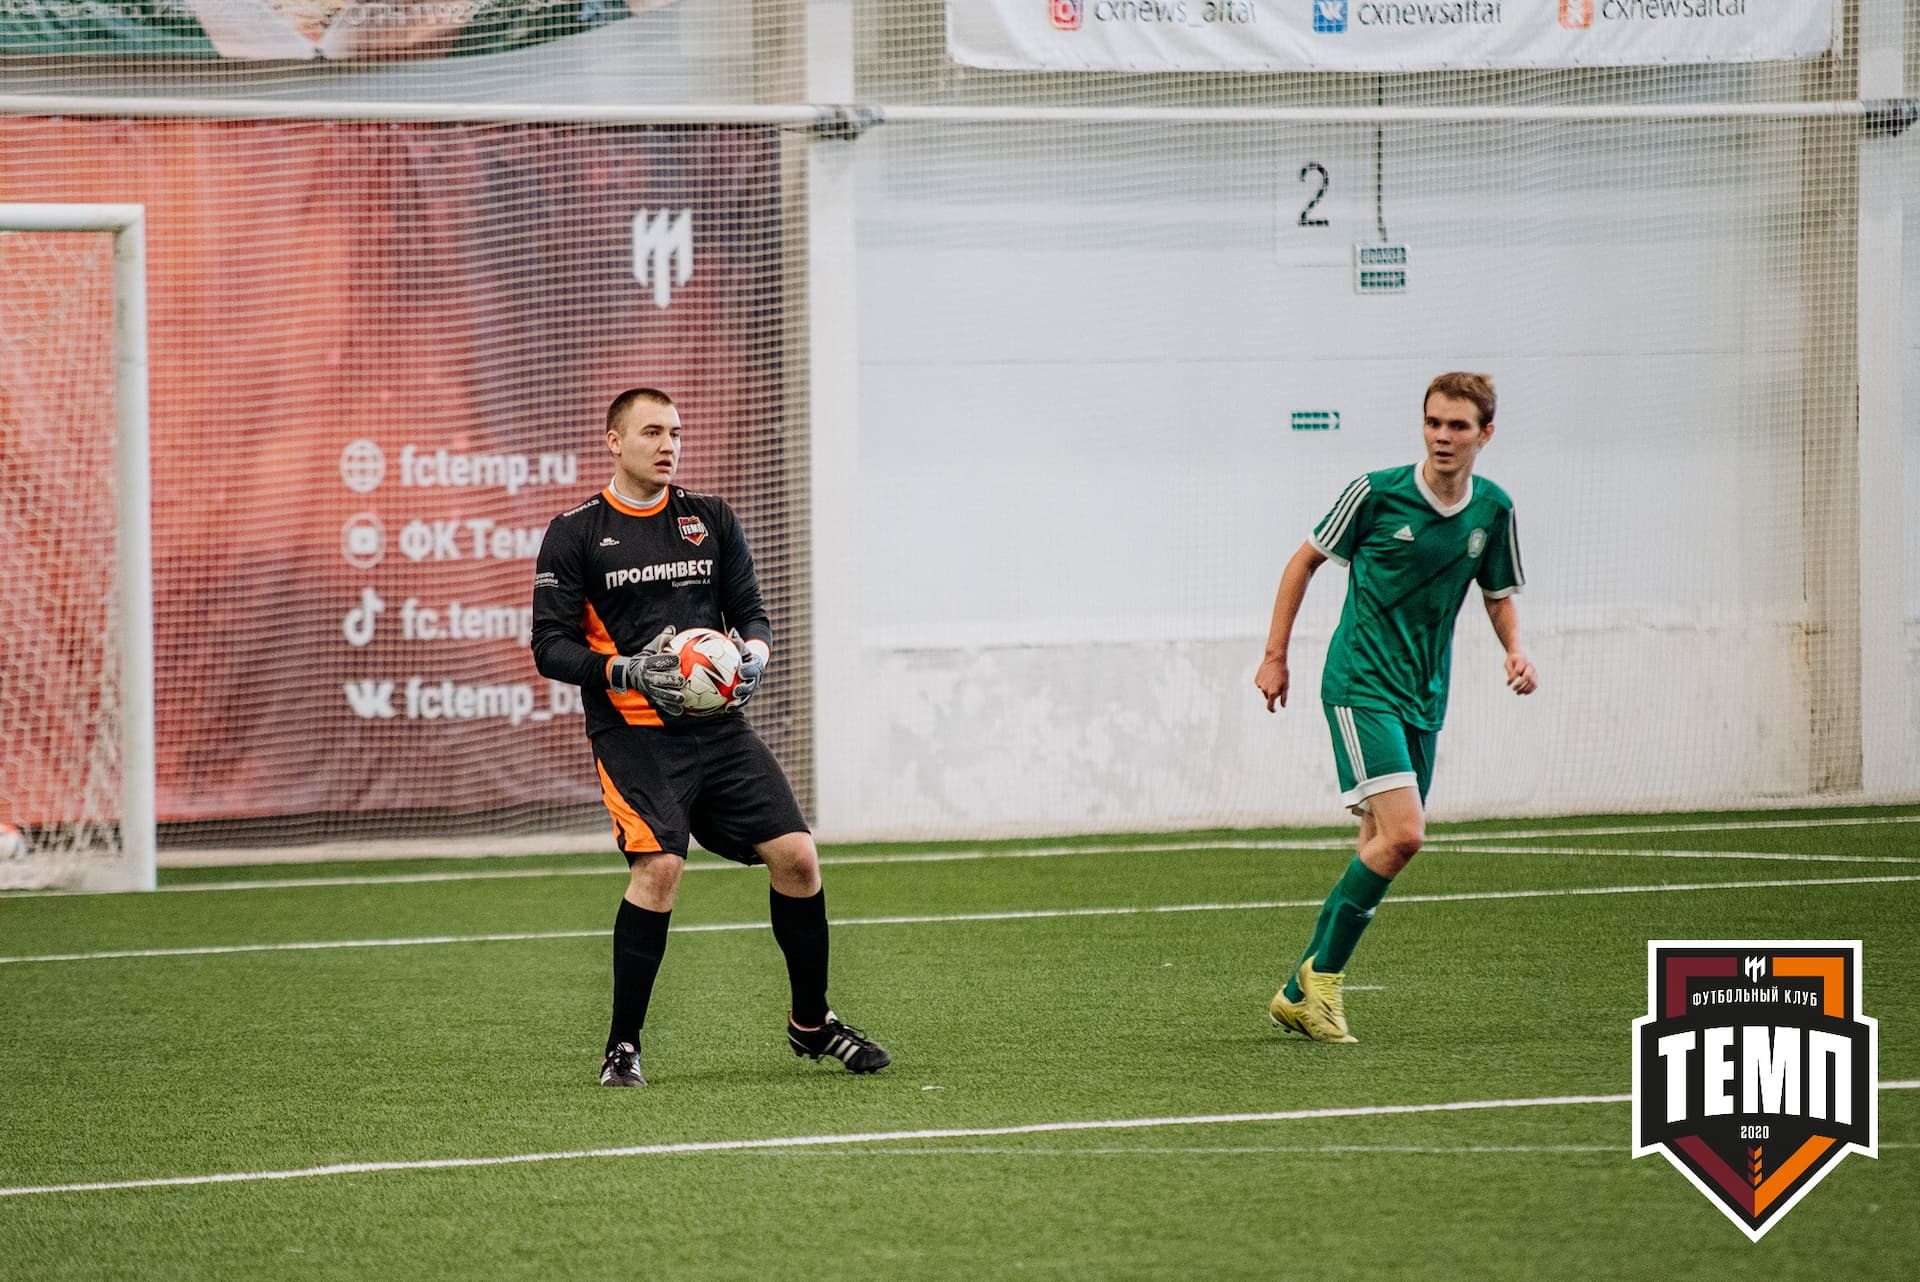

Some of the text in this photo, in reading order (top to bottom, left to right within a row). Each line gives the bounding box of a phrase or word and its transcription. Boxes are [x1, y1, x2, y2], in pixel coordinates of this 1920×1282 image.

[1299, 161, 1329, 227] 2
[402, 445, 578, 495] fctemp.ru
[401, 519, 545, 561] ФК Тем
[605, 560, 713, 590] ПРОДИНВЕСТ
